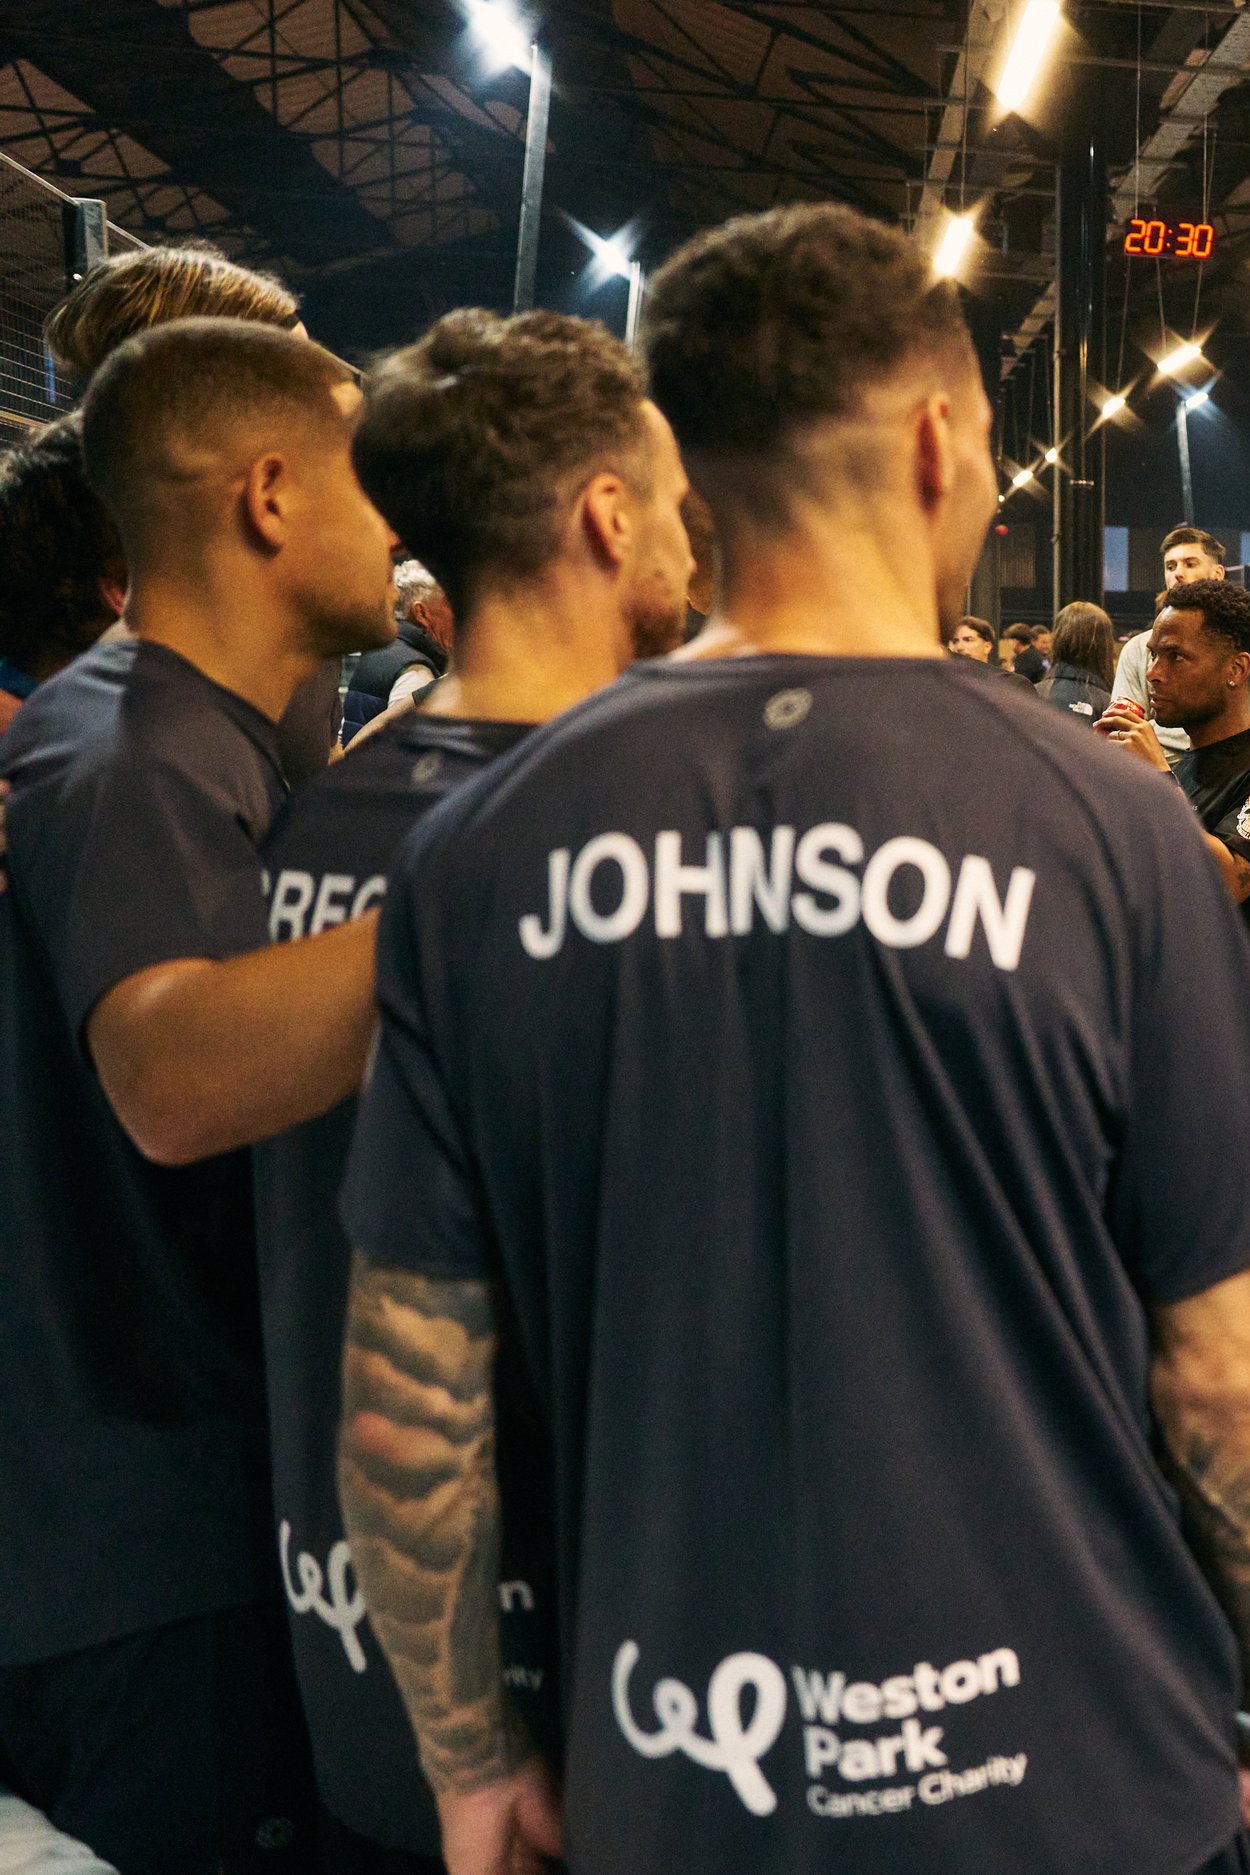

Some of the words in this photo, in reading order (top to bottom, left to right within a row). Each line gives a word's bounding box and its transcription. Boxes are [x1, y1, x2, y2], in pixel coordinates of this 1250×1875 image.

[1125, 219, 1213, 257] 20:30
[519, 822, 1036, 971] JOHNSON
[791, 1647, 1021, 1724] Weston
[803, 1717, 949, 1782] Park
[807, 1784, 917, 1818] Cancer
[917, 1752, 1028, 1805] Charity
